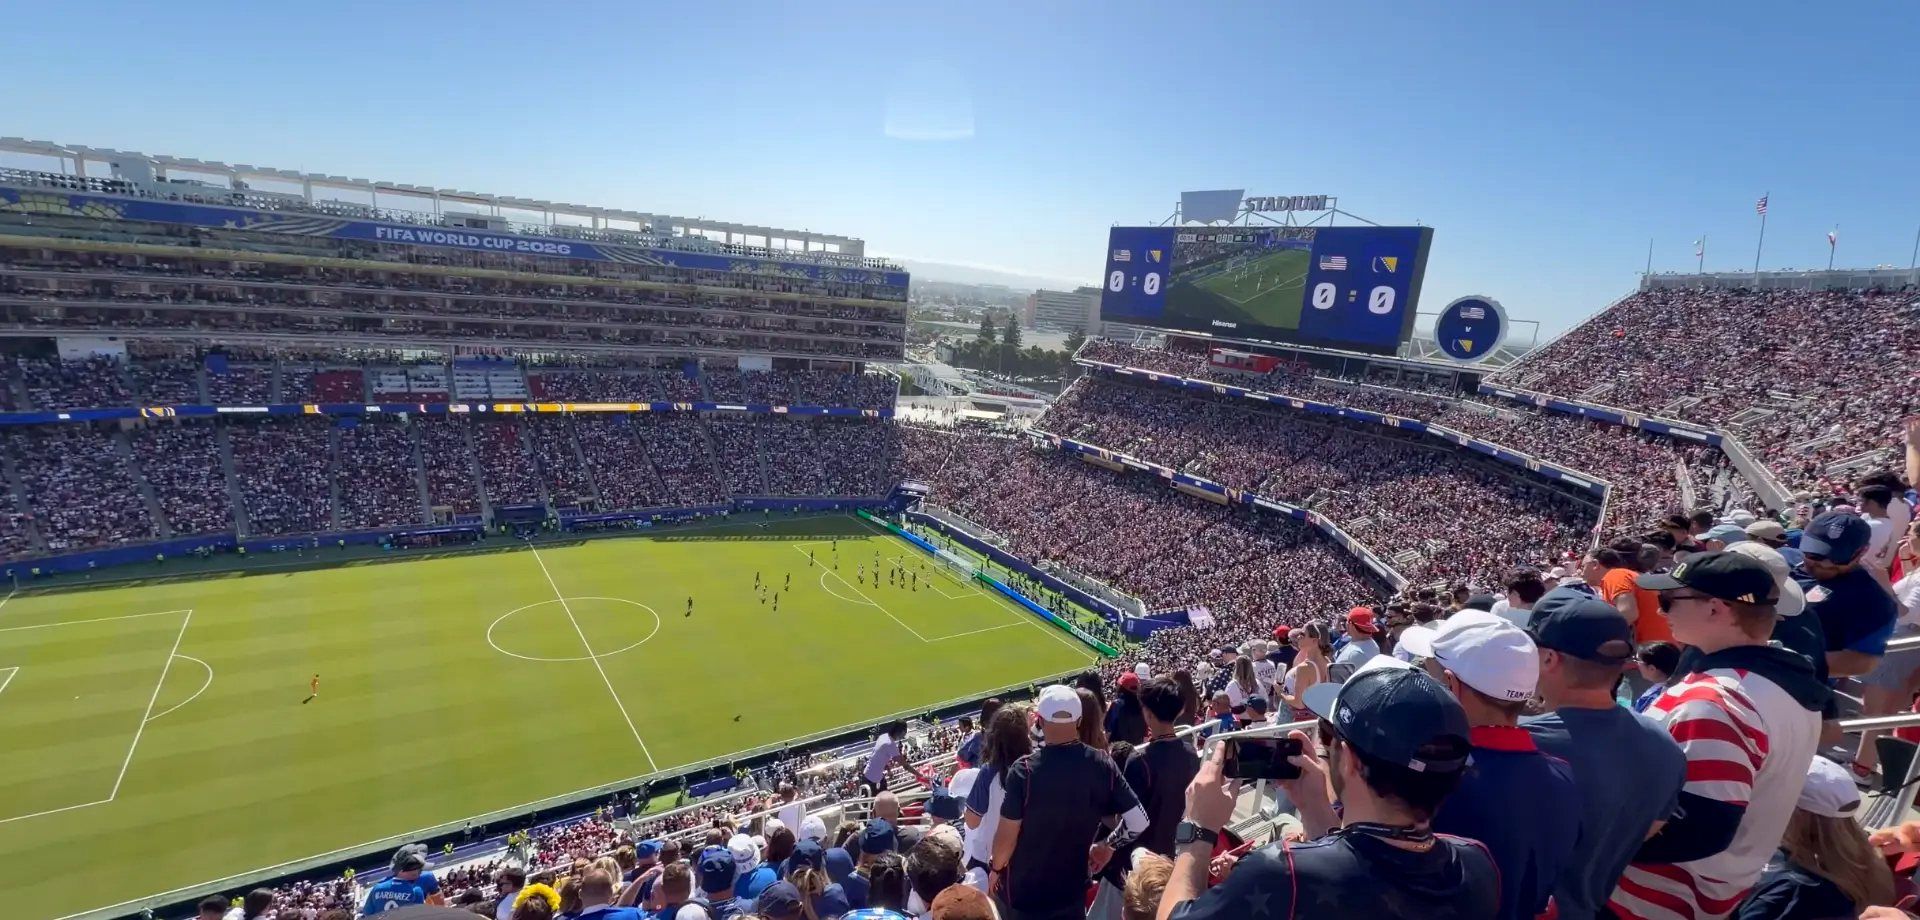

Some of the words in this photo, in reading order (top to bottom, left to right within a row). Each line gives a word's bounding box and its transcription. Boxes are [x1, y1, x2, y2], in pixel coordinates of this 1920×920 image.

[1245, 195, 1327, 212] STADIUM
[375, 226, 414, 241] FIFA
[416, 231, 480, 247] WORLD
[483, 237, 514, 250] CUP
[516, 240, 571, 255] 2026
[1109, 270, 1125, 292] 0
[1143, 272, 1160, 295] 0
[1312, 282, 1336, 310] 0
[1368, 285, 1396, 314] 0
[1212, 319, 1237, 329] Hisense
[1506, 689, 1525, 699] TEAM
